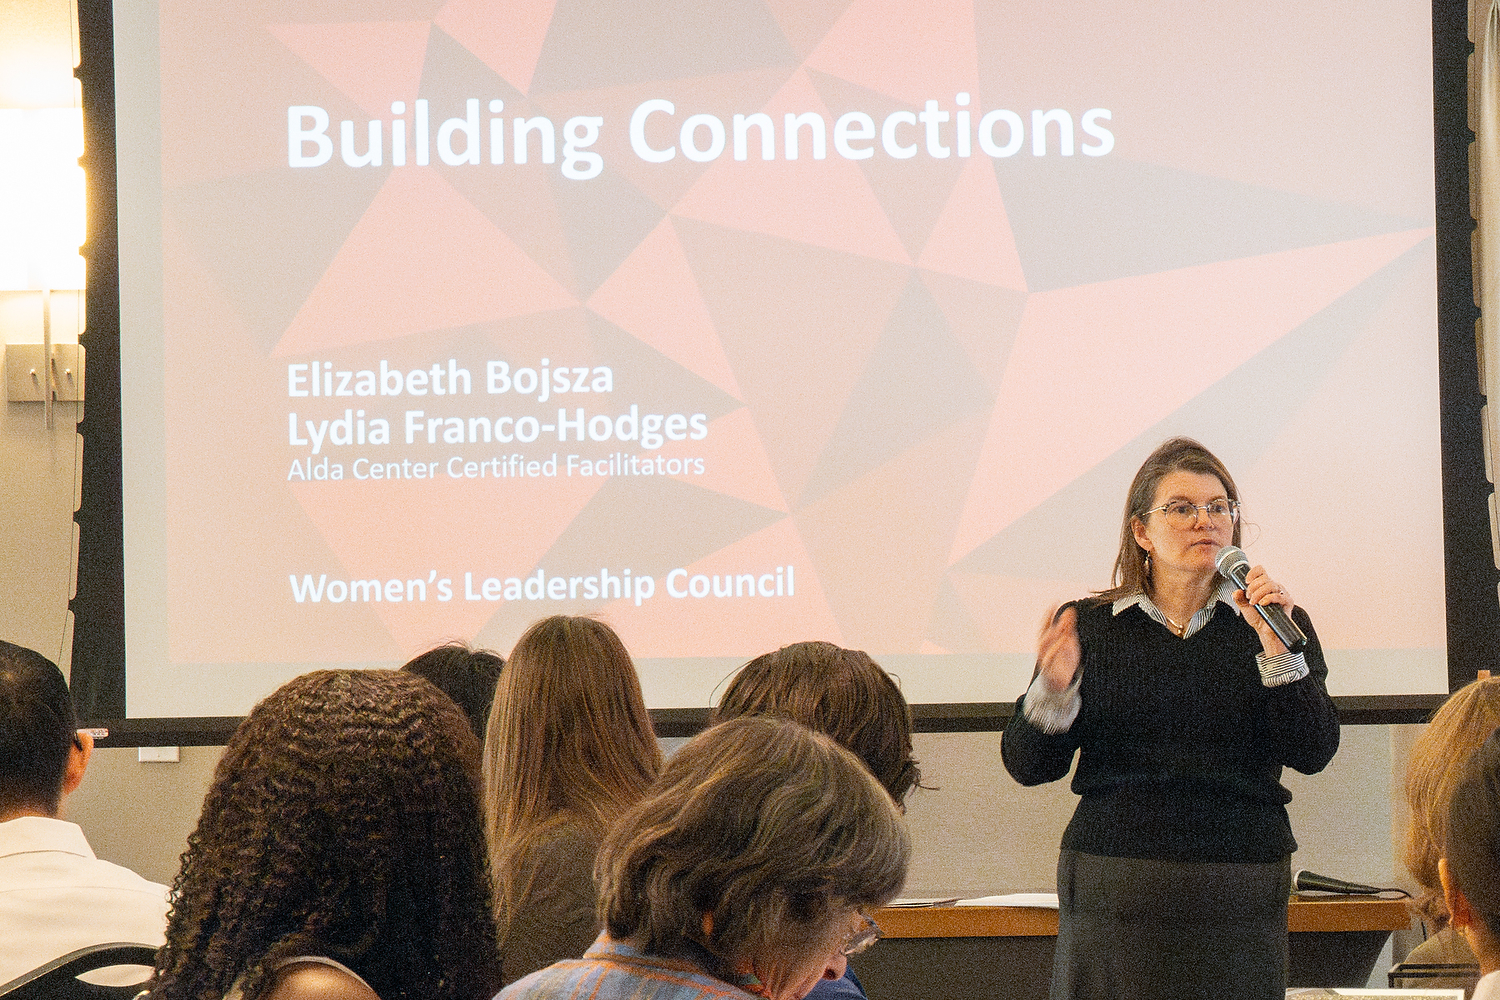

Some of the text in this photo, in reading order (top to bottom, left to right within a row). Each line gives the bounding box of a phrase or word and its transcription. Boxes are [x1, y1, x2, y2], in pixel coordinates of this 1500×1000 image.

[286, 92, 1116, 181] Building Connections
[287, 358, 614, 403] Elizabeth Bojsza
[287, 404, 709, 455] Lydia Franco-Hodges
[286, 451, 706, 481] Alda Center Certified Facilitators
[288, 565, 795, 606] Women’s Leadership Council
